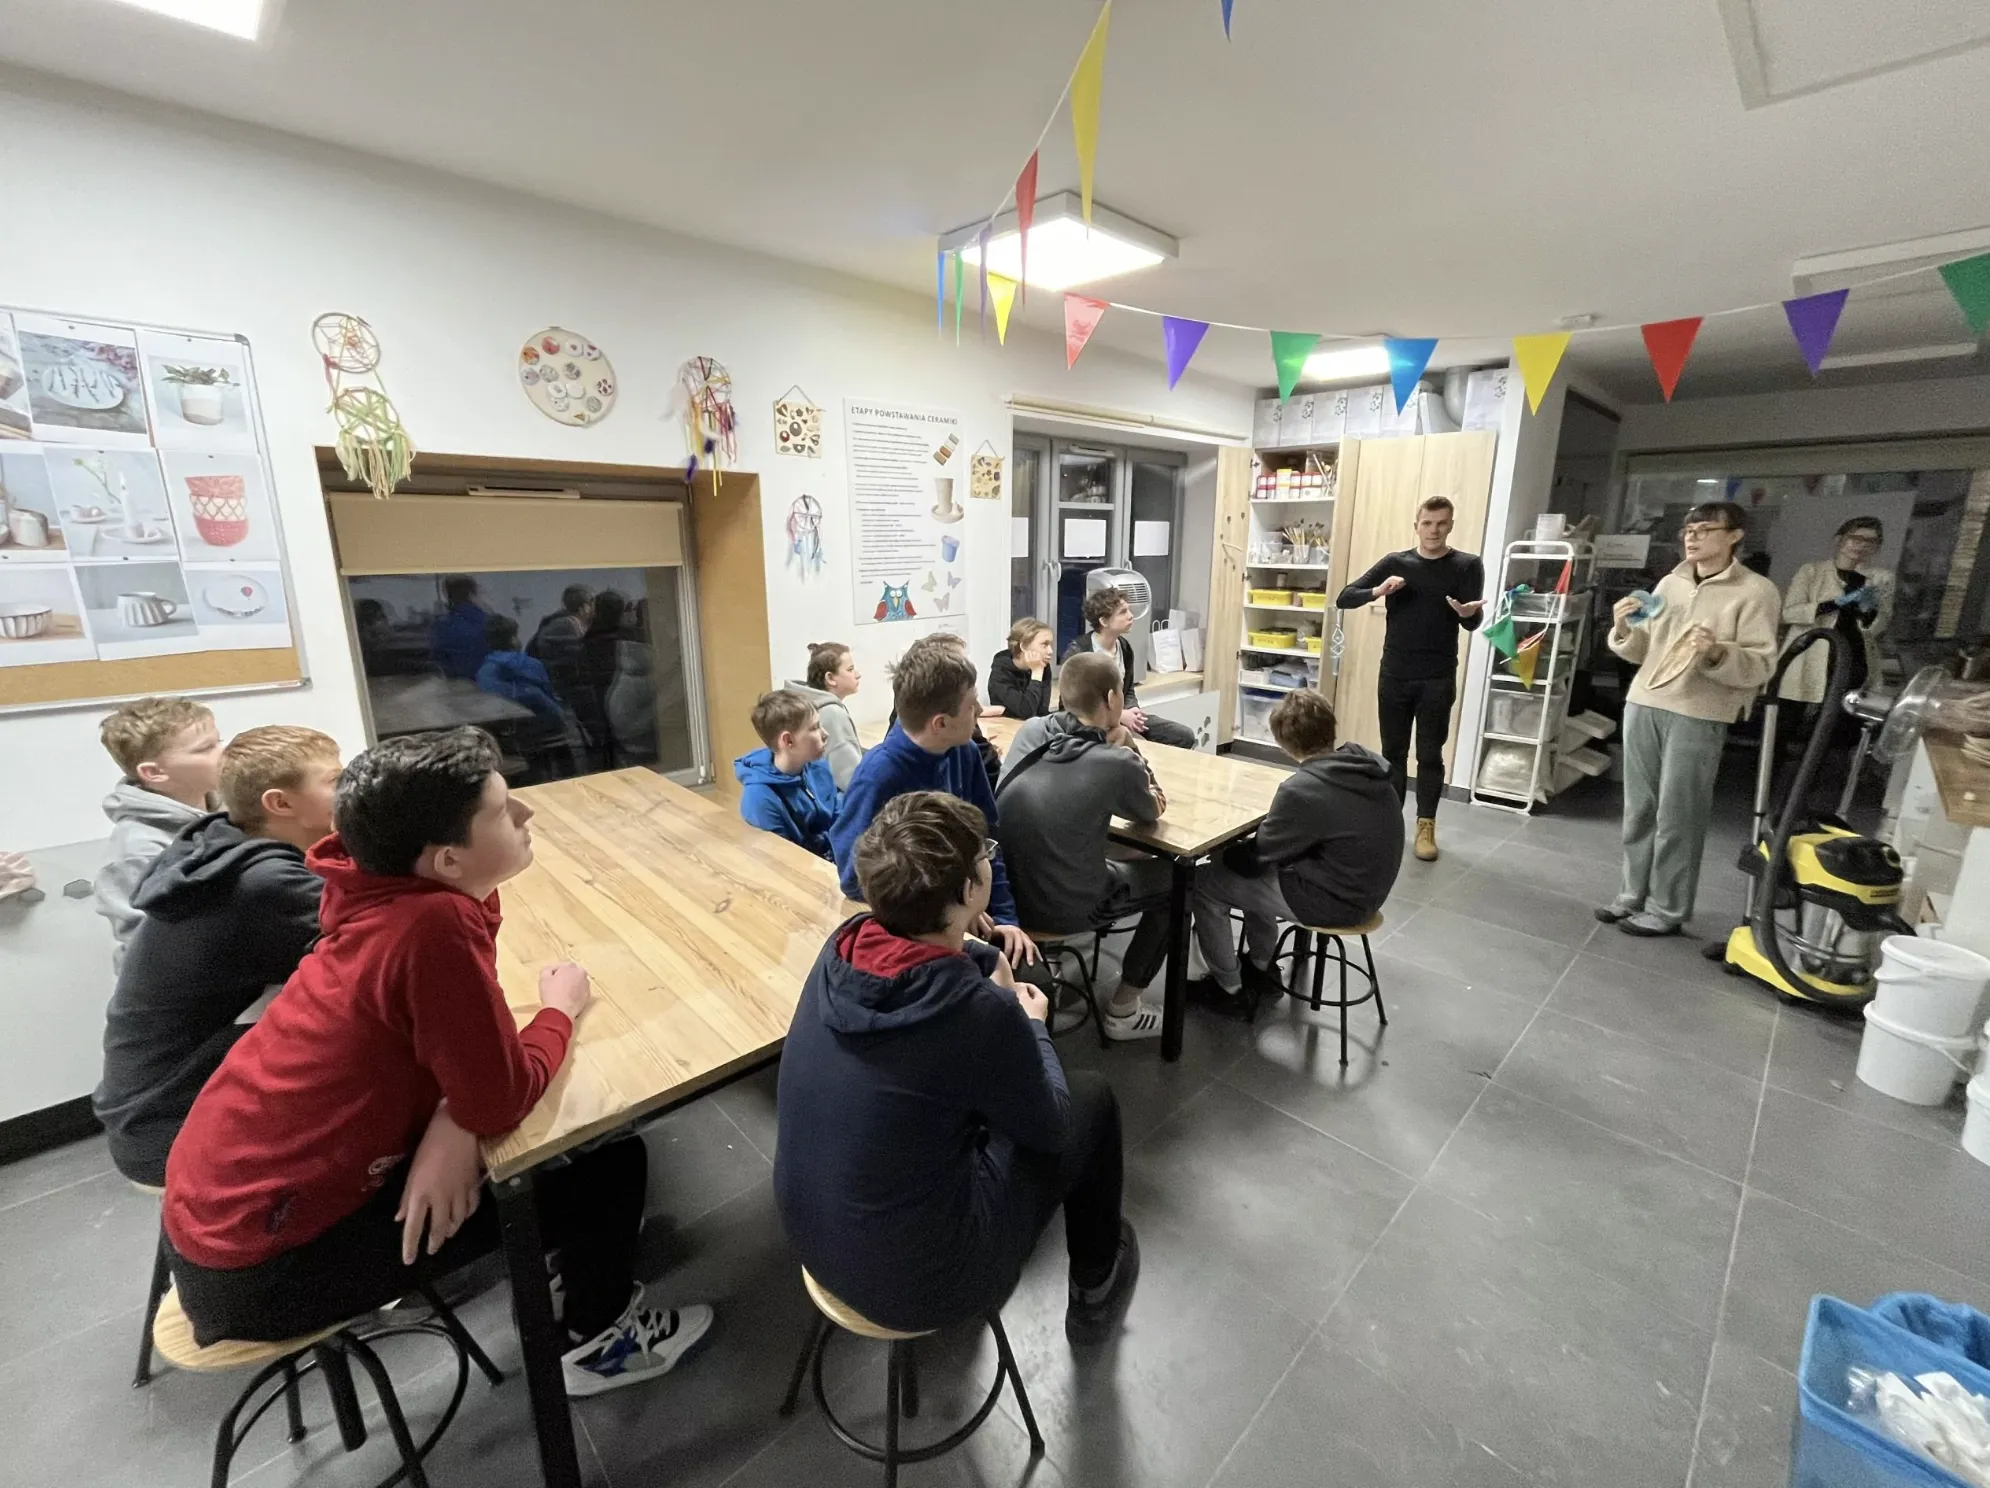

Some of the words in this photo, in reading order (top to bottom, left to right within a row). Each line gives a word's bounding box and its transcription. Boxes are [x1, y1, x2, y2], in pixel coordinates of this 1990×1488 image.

[851, 406, 873, 416] ETAPY
[874, 408, 926, 421] POWSTAWANIA
[927, 415, 958, 425] CERAMIKI
